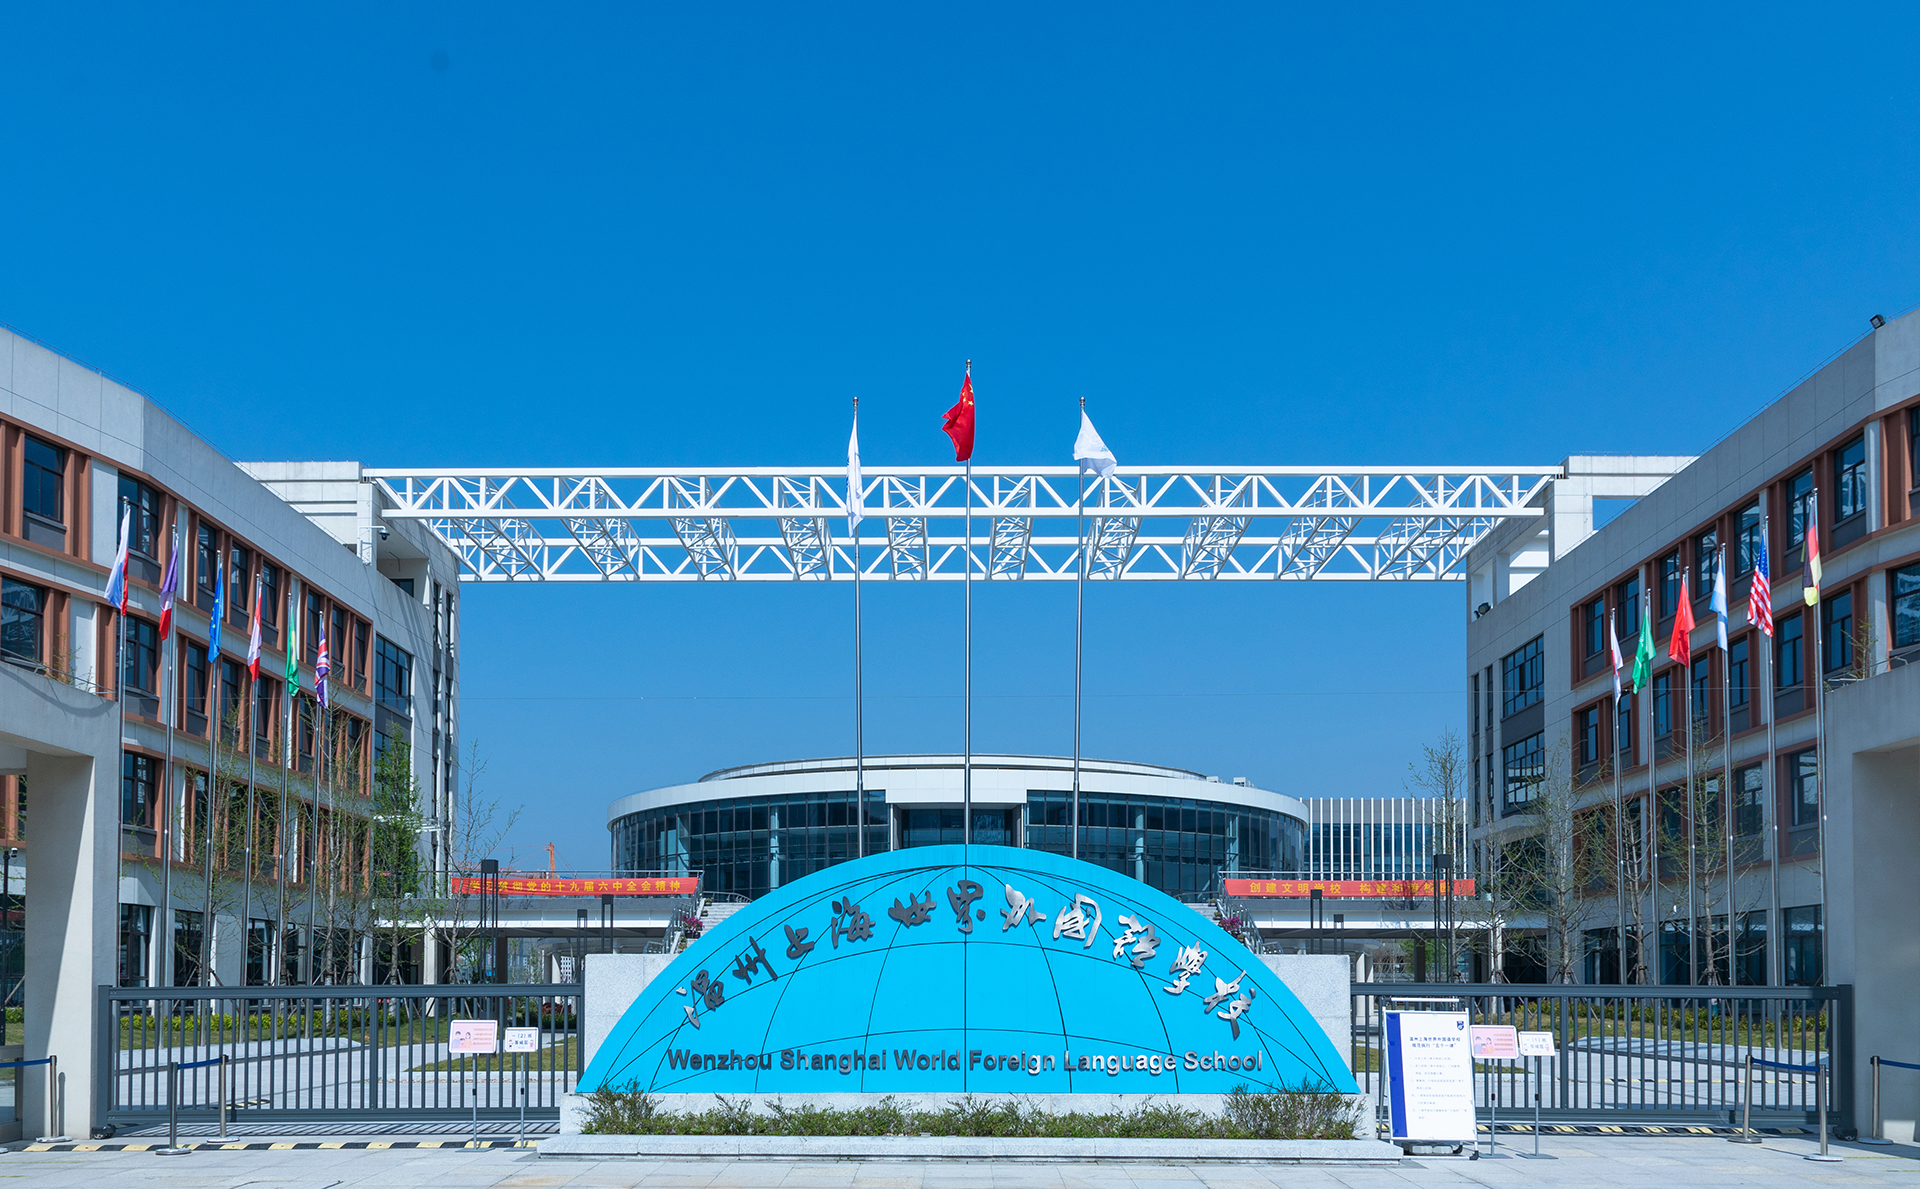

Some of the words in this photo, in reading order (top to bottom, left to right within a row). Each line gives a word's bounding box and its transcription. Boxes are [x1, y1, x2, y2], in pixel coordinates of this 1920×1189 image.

[668, 1049, 772, 1071] Wenzhou
[780, 1049, 887, 1076] Shanghai
[893, 1049, 961, 1071] World
[969, 1049, 1056, 1076] Foreign
[1063, 1050, 1177, 1076] Language
[1183, 1050, 1263, 1072] School
